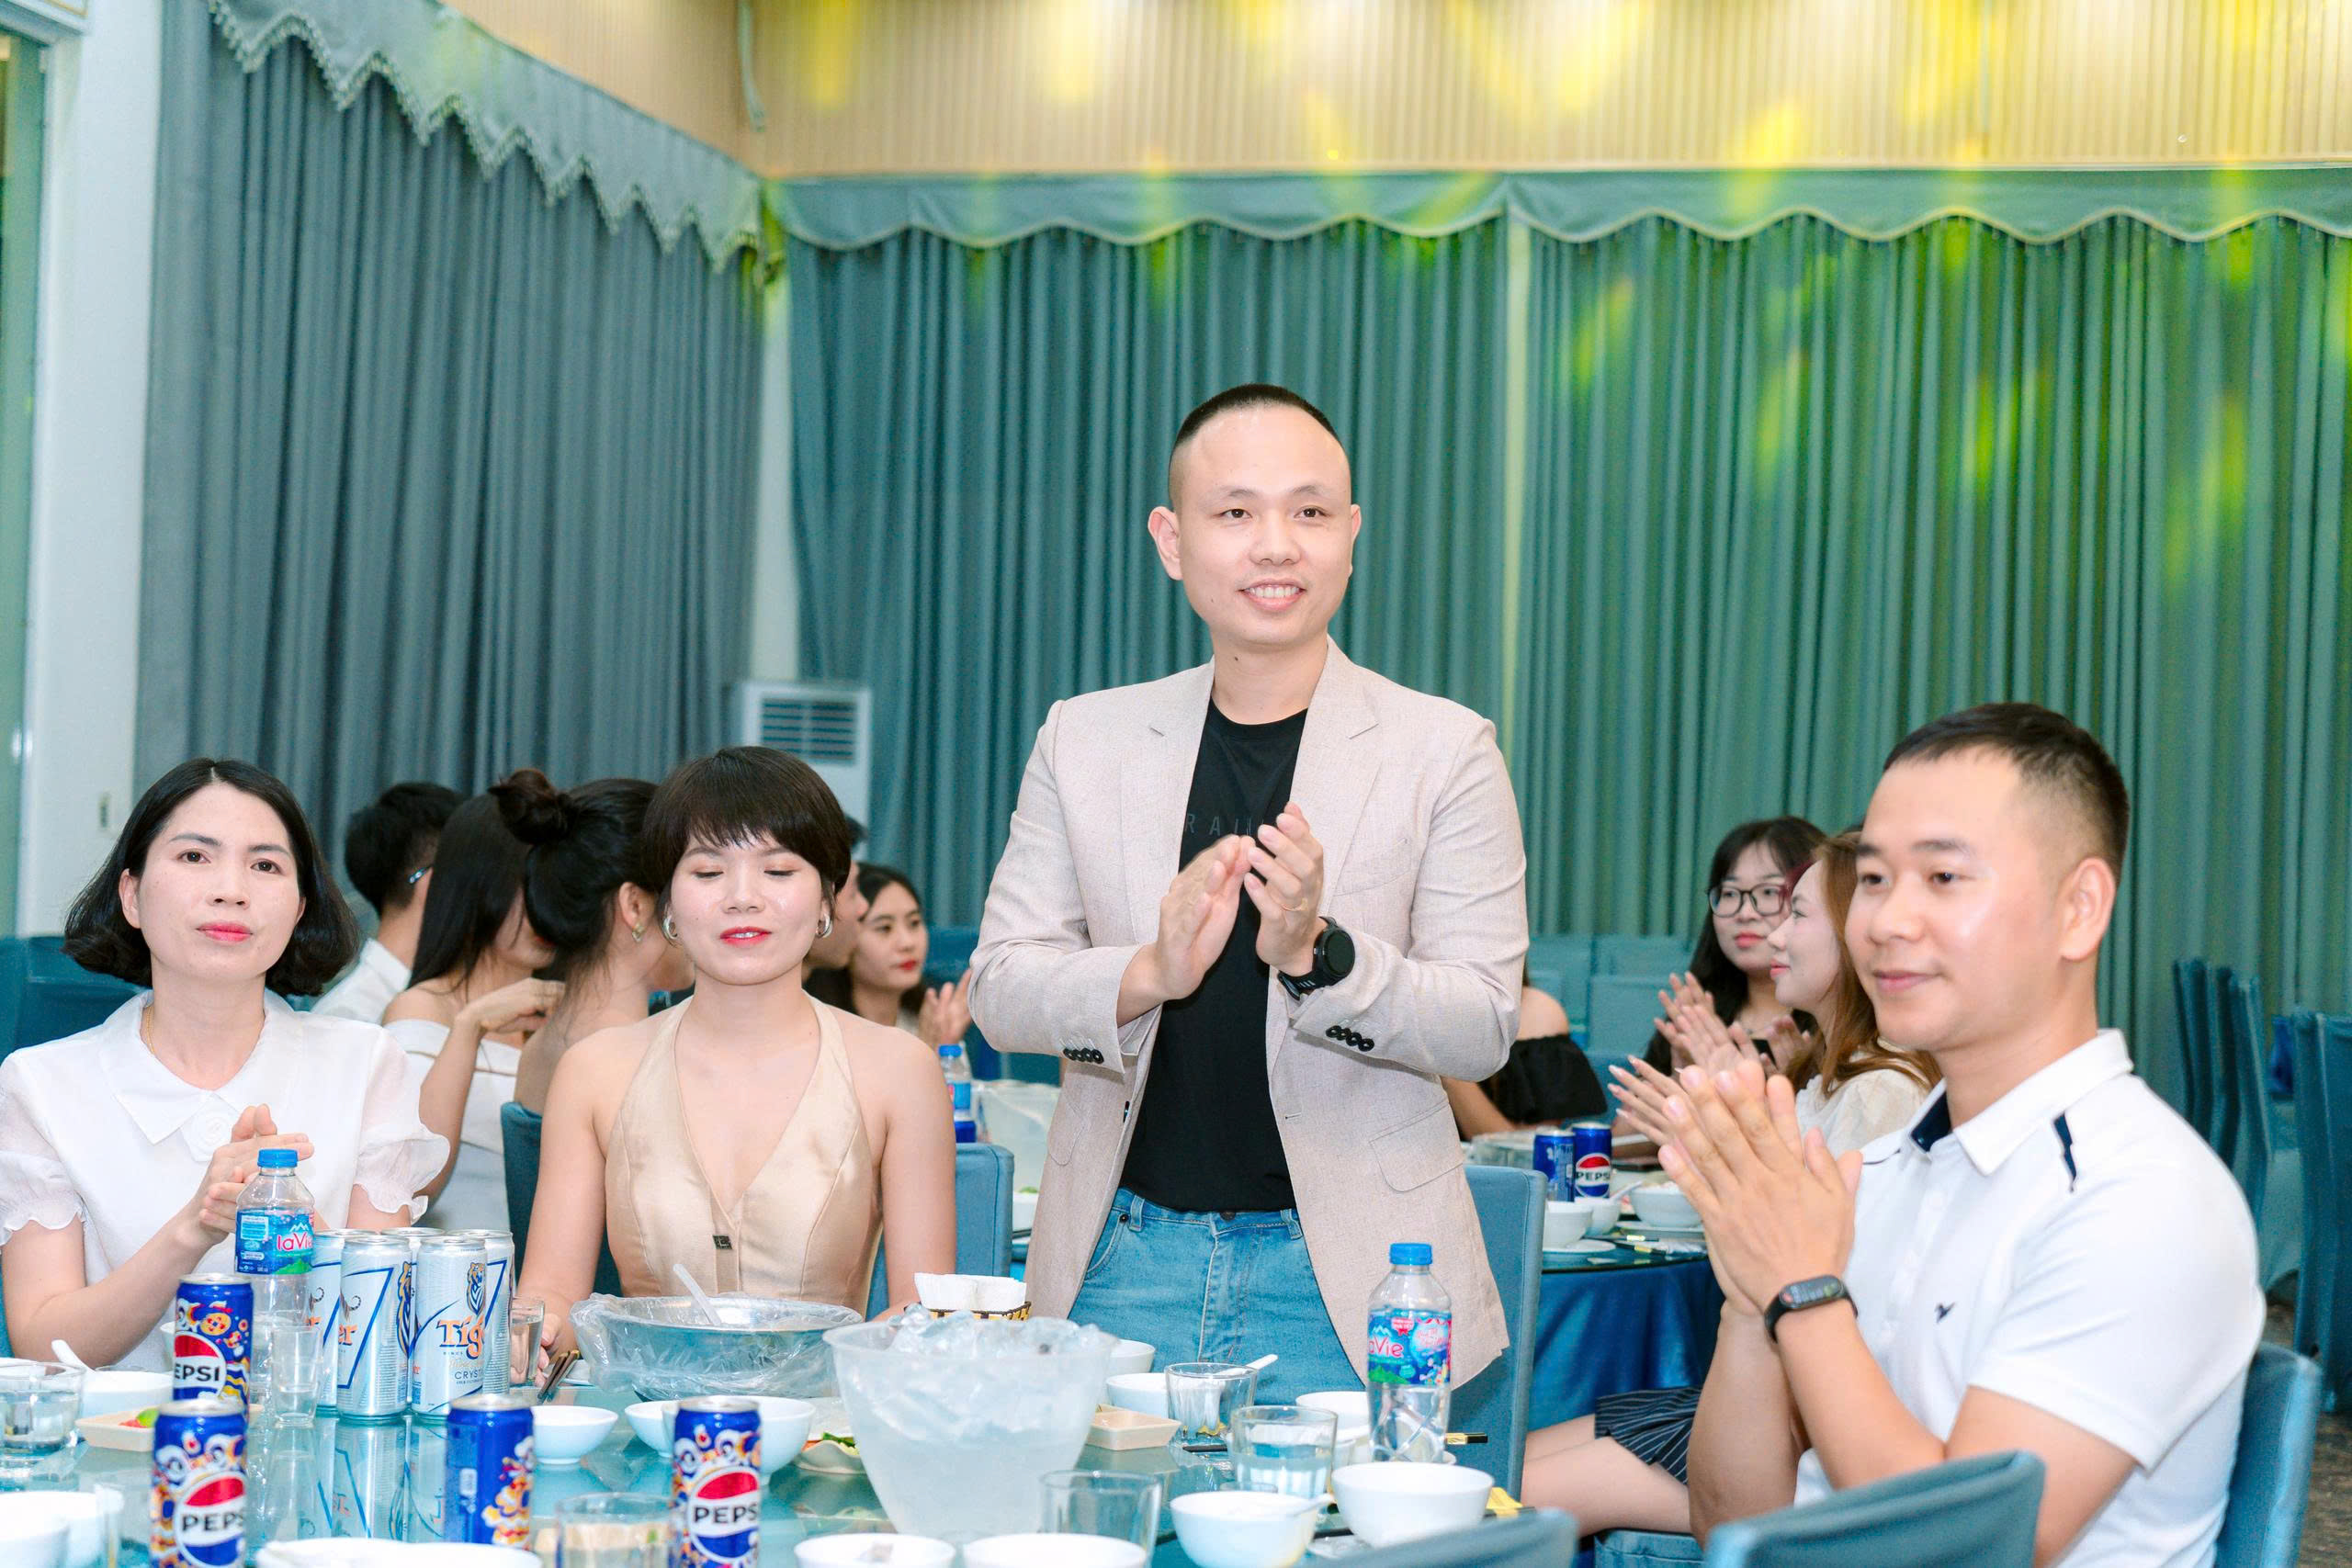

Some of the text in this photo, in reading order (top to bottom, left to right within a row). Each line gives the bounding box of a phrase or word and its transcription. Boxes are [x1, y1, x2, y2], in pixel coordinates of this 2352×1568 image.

[436, 1314, 485, 1359] Tig
[1368, 1337, 1404, 1358] aVie
[175, 1363, 220, 1382] EPSI
[694, 1503, 758, 1523] PEPS
